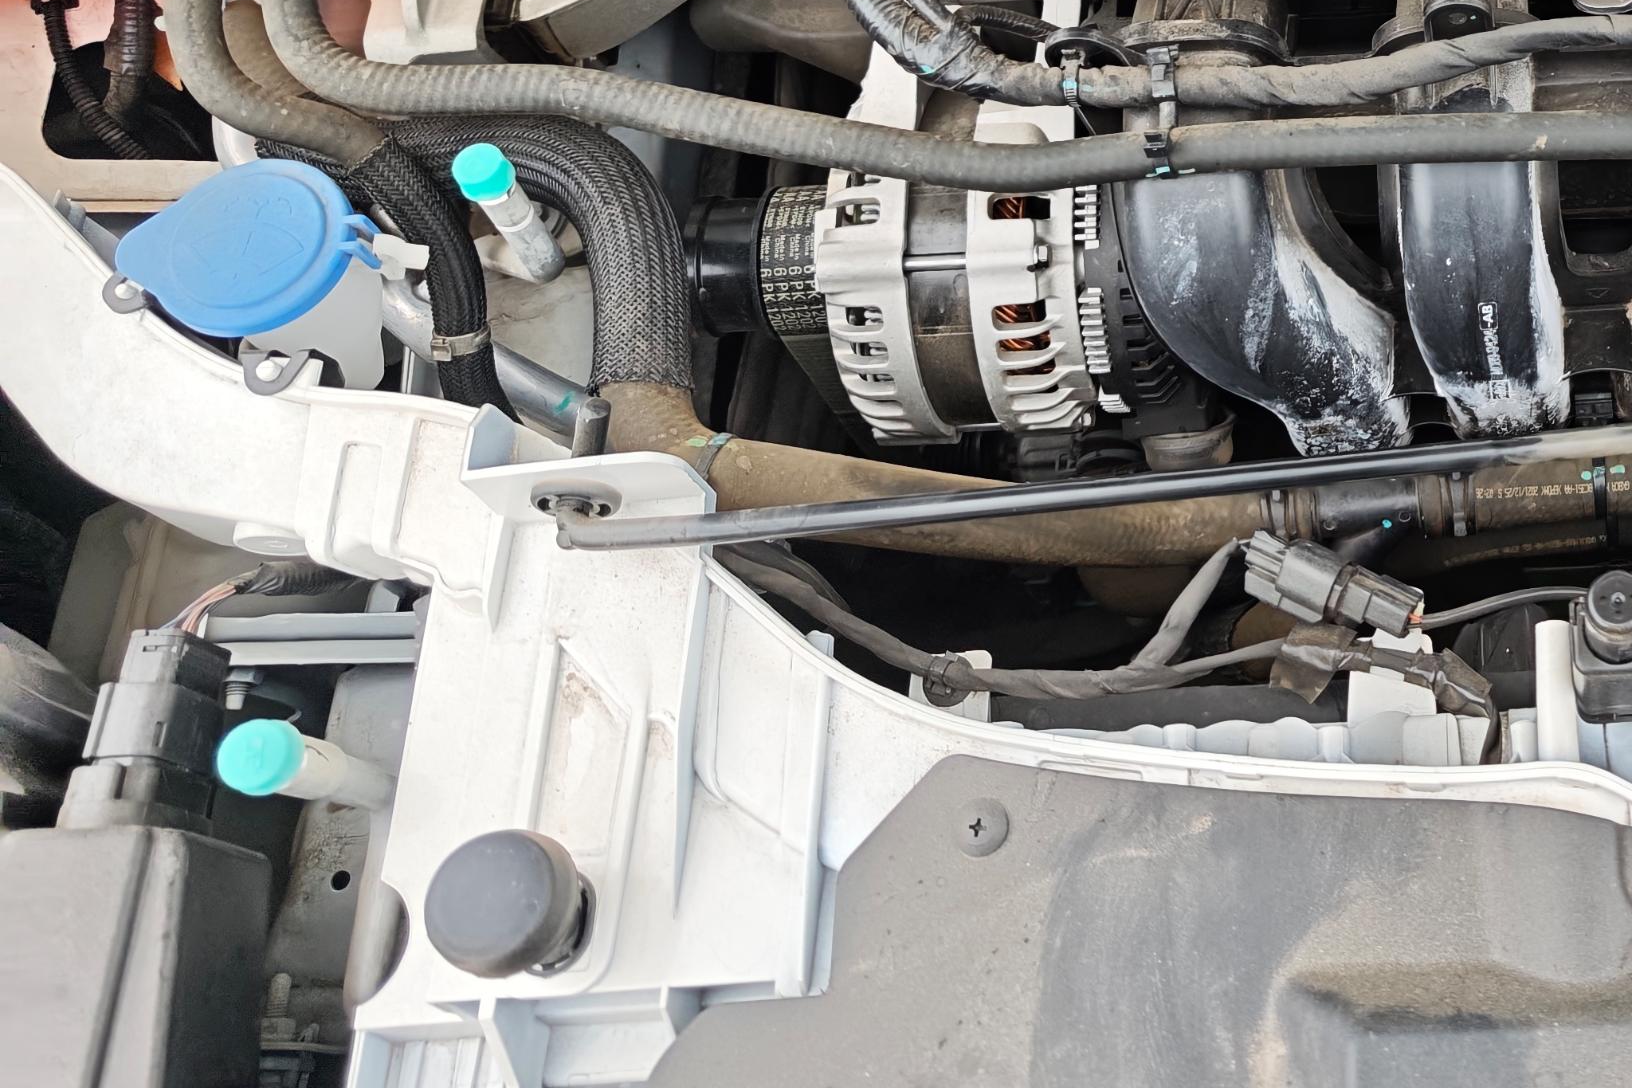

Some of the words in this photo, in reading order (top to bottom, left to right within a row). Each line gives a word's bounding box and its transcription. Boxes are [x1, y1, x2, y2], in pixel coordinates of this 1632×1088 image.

[773, 266, 787, 277] 6
[788, 265, 802, 276] 6
[775, 282, 791, 302] PK
[789, 281, 806, 302] PK
